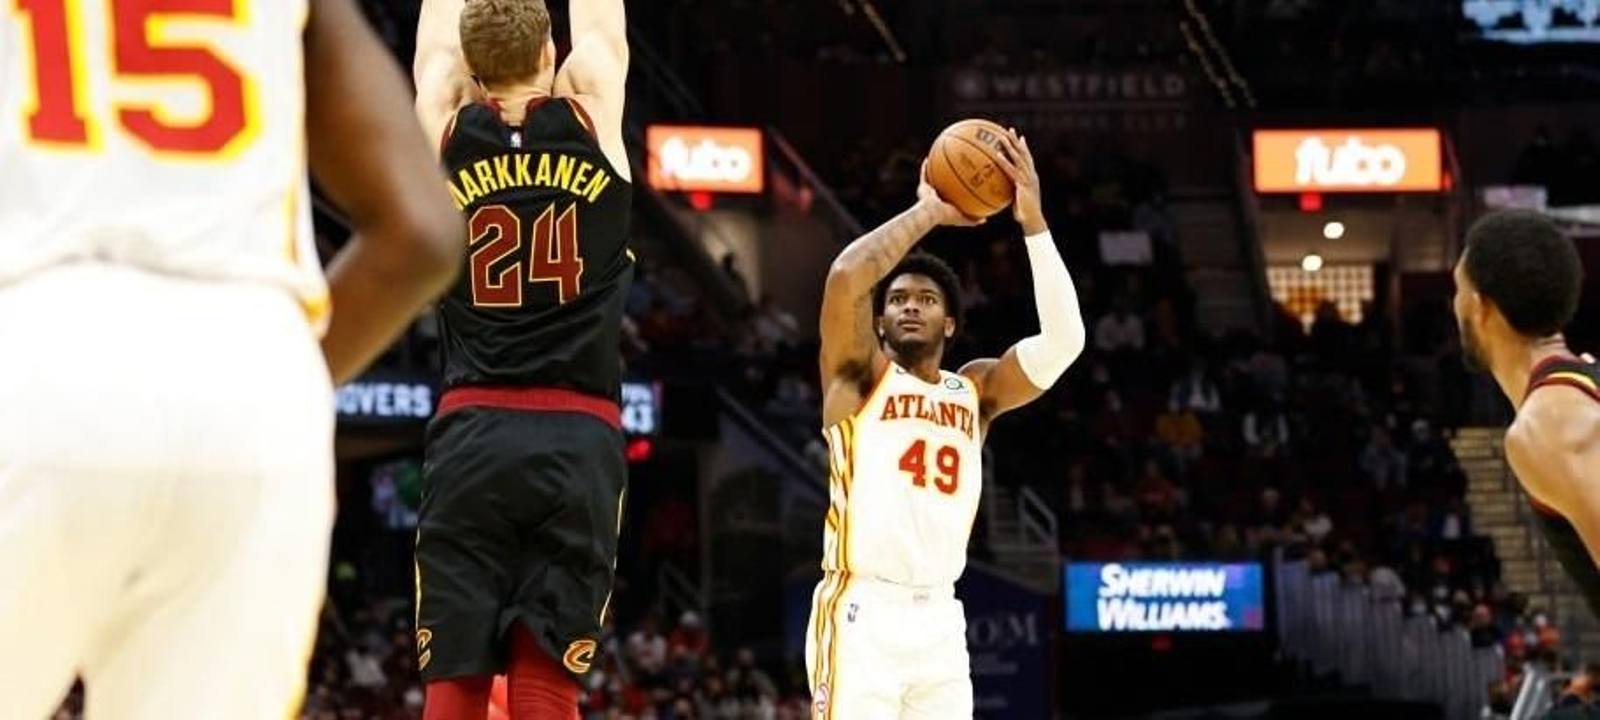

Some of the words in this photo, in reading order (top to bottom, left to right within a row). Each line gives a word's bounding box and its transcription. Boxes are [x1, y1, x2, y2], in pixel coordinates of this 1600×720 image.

[12, 0, 262, 162] 15
[660, 135, 752, 183] fubo
[1295, 135, 1406, 187] fubo
[469, 201, 583, 308] 24
[880, 394, 974, 440] ATLANTA
[898, 438, 960, 495] 49
[1098, 562, 1226, 598] SHERWIN
